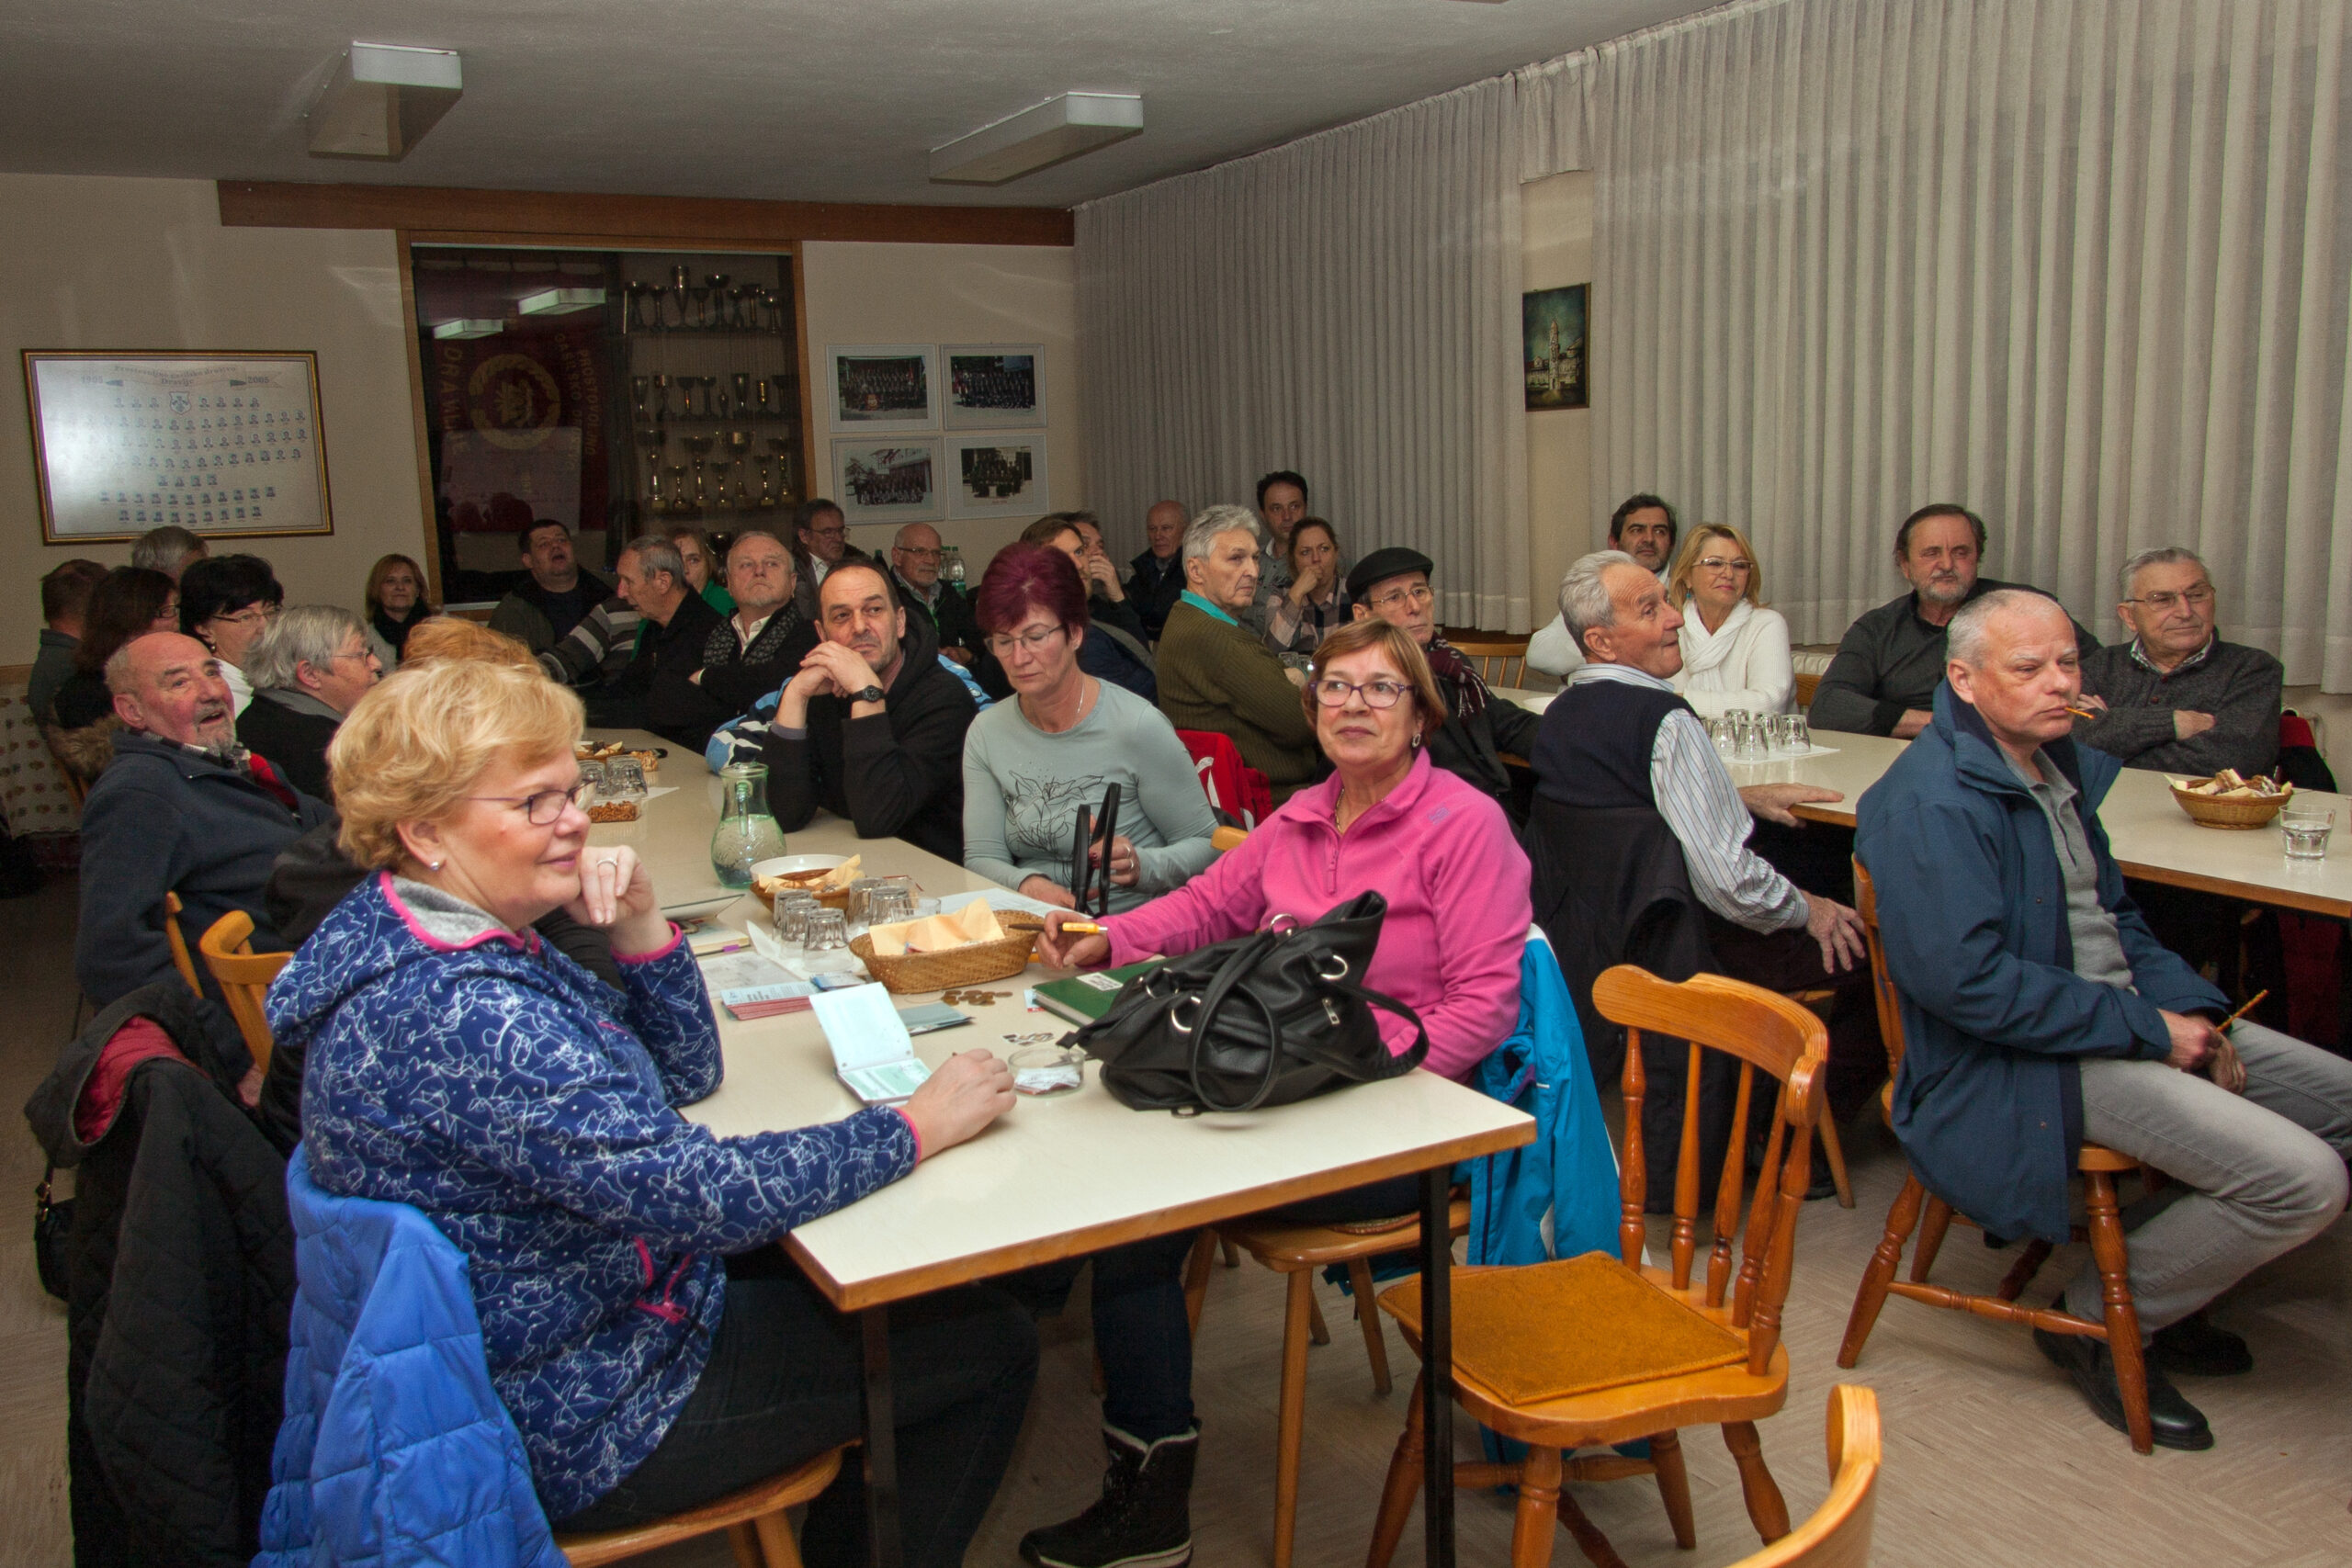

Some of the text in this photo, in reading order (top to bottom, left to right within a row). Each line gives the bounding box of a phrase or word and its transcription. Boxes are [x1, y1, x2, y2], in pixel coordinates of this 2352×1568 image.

[441, 346, 470, 455] DRAVLJE
[555, 333, 582, 400] GASILSKO
[577, 349, 599, 456] PROSTOVOLJNO
